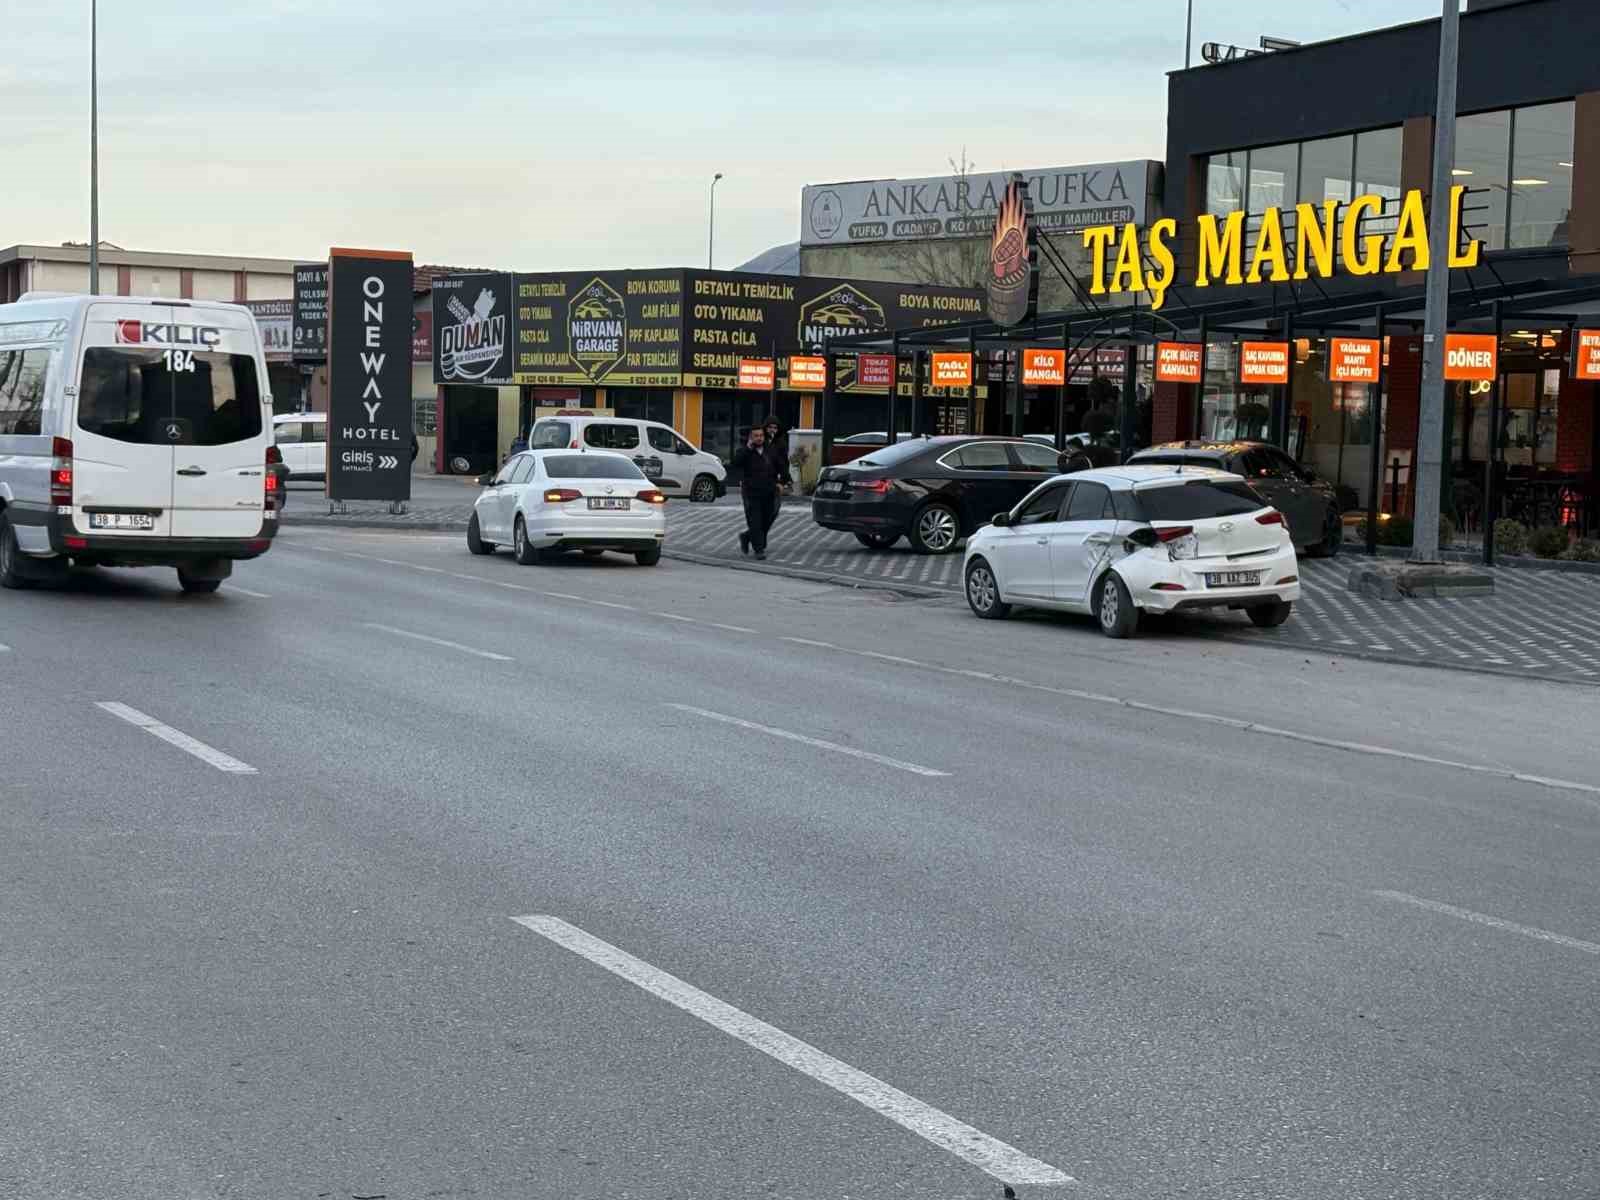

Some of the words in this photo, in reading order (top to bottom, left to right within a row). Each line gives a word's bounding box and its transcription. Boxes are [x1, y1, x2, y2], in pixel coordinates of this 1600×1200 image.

[863, 179, 1000, 218] ANKARA
[851, 224, 884, 238] YUFKA
[1083, 218, 1176, 310] TAŞ
[1196, 186, 1479, 287] MANGAL
[627, 280, 646, 295] BOYA
[648, 279, 680, 293] KORUMA
[695, 280, 740, 297] DETAYLI
[743, 282, 794, 300] TEMİZLİK
[642, 304, 659, 318] CAM
[900, 294, 930, 308] BOYA
[933, 296, 981, 312] KORUMA
[694, 304, 716, 319] OTO
[720, 306, 764, 323] YIKAMA
[142, 324, 220, 352] KILIÇ
[441, 315, 504, 356] DUMAN
[629, 329, 642, 343] PPF
[644, 328, 680, 342] KAPLAMA
[694, 328, 729, 345] PASTA
[731, 328, 757, 346] CİLA
[576, 338, 618, 353] GARAGE
[163, 350, 195, 373] 184
[627, 353, 641, 367] FAR
[1033, 353, 1054, 367] KİLO
[1160, 348, 1178, 362] AÇIK
[1179, 348, 1199, 362] BÜFE
[1447, 347, 1492, 368] DÖNER
[936, 359, 967, 370] YAĞLI
[1024, 368, 1062, 380] MANGAL
[343, 428, 399, 441] HOTEL
[342, 449, 374, 467] GİRİŞ
